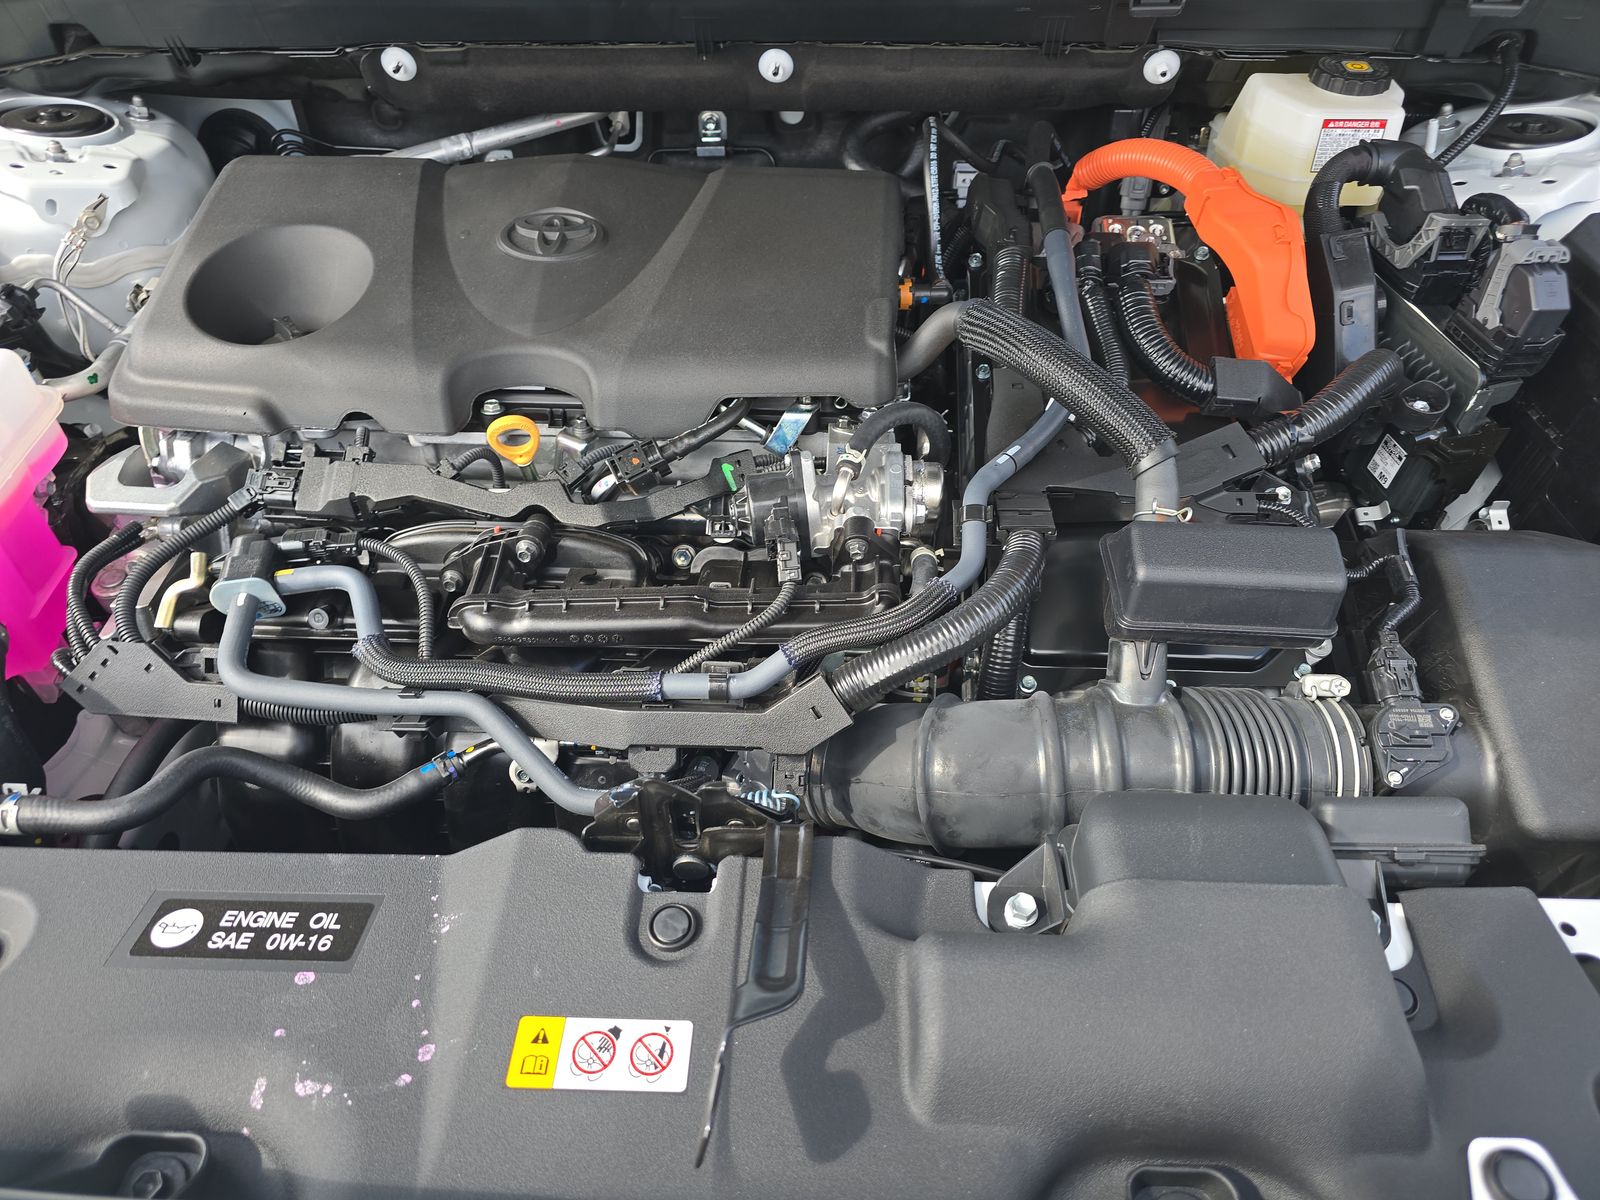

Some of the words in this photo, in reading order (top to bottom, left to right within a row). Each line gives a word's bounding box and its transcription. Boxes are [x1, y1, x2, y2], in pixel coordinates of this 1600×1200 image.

[1377, 471, 1388, 484] M9
[219, 910, 299, 929] ENGINE
[309, 912, 341, 929] OIL
[207, 931, 254, 950] SAE
[265, 933, 334, 951] 0W-16
